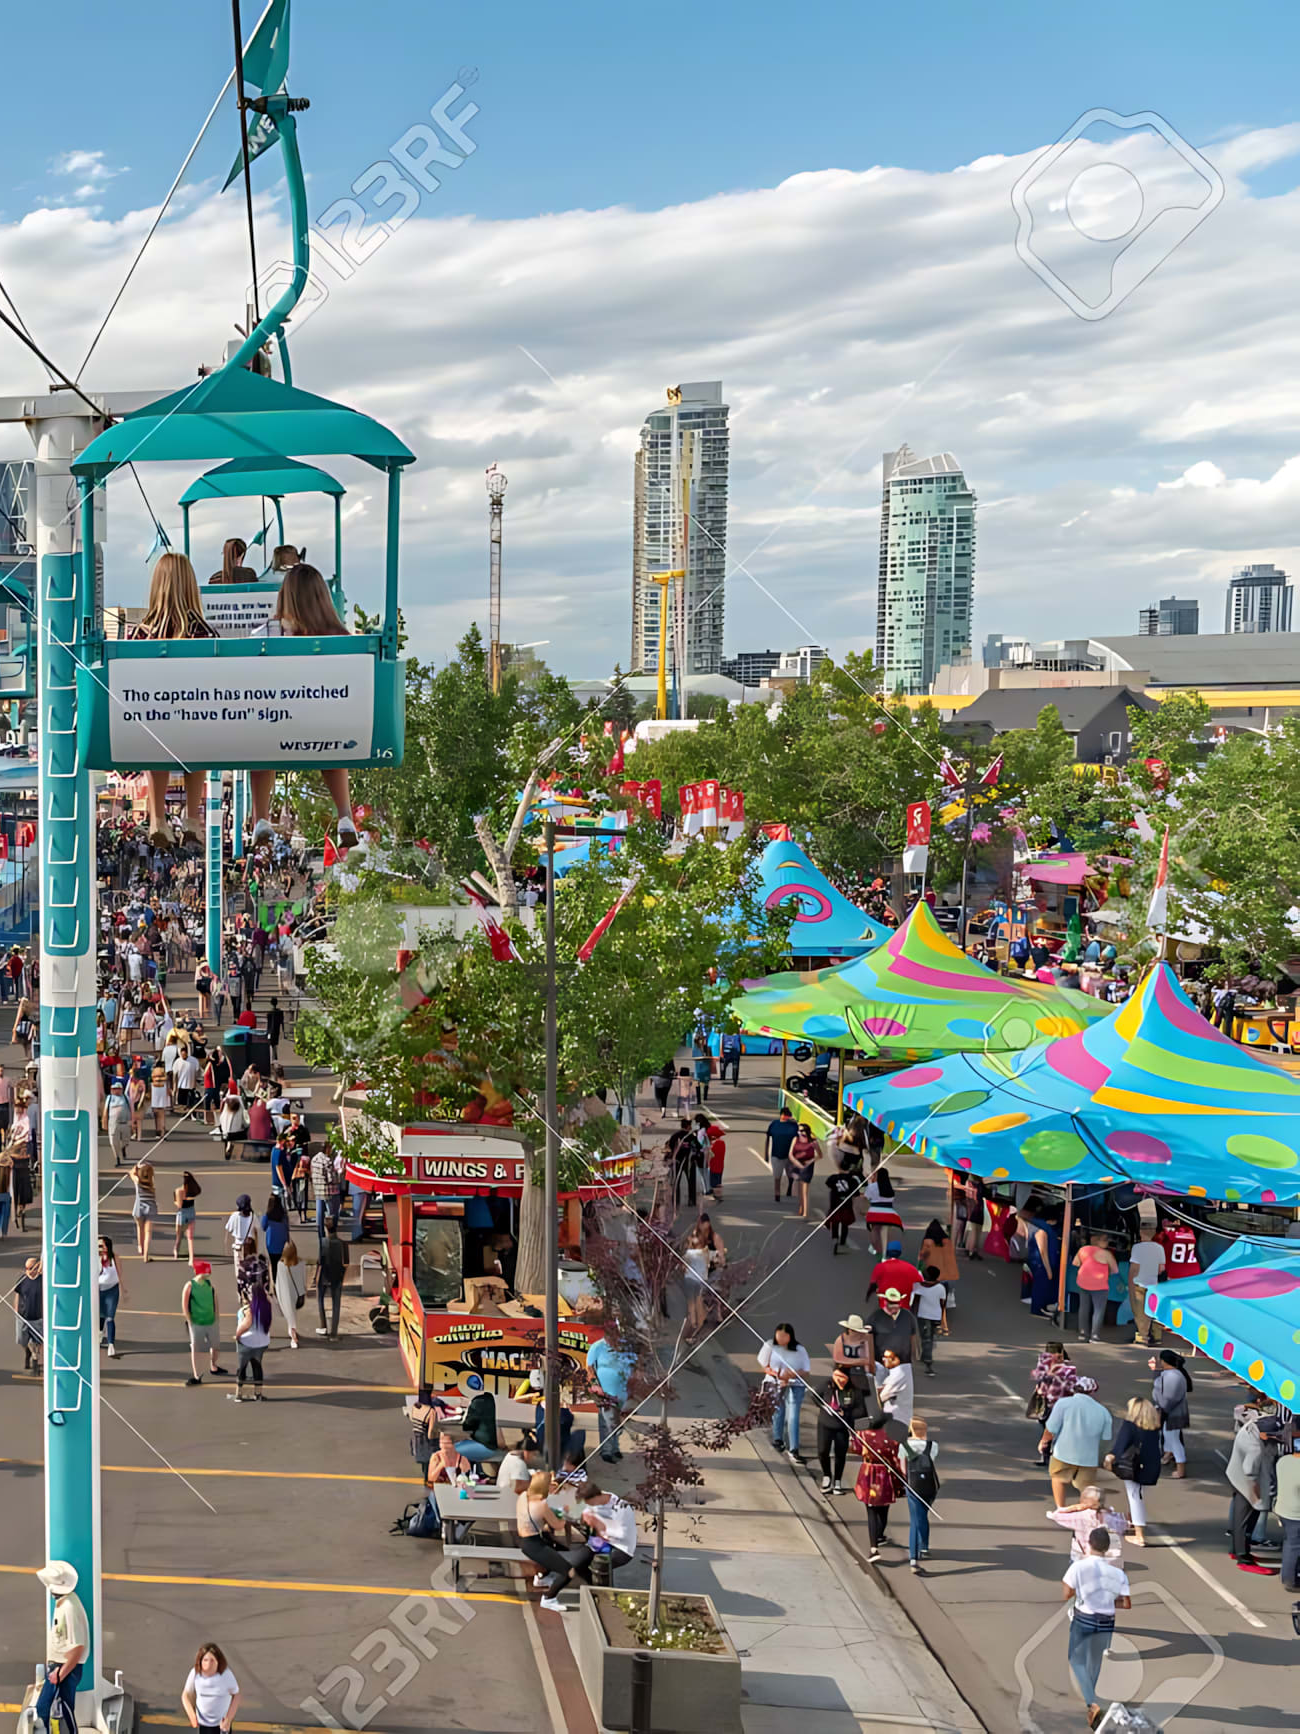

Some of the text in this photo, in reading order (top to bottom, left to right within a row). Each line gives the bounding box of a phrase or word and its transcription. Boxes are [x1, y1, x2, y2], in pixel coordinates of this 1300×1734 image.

[153, 687, 210, 705] captain
[213, 687, 241, 701] has
[244, 687, 277, 700] now
[280, 684, 349, 700] switched
[123, 709, 142, 722] on
[146, 708, 171, 721] the
[424, 1159, 488, 1178] WINGS
[493, 1160, 508, 1179] &
